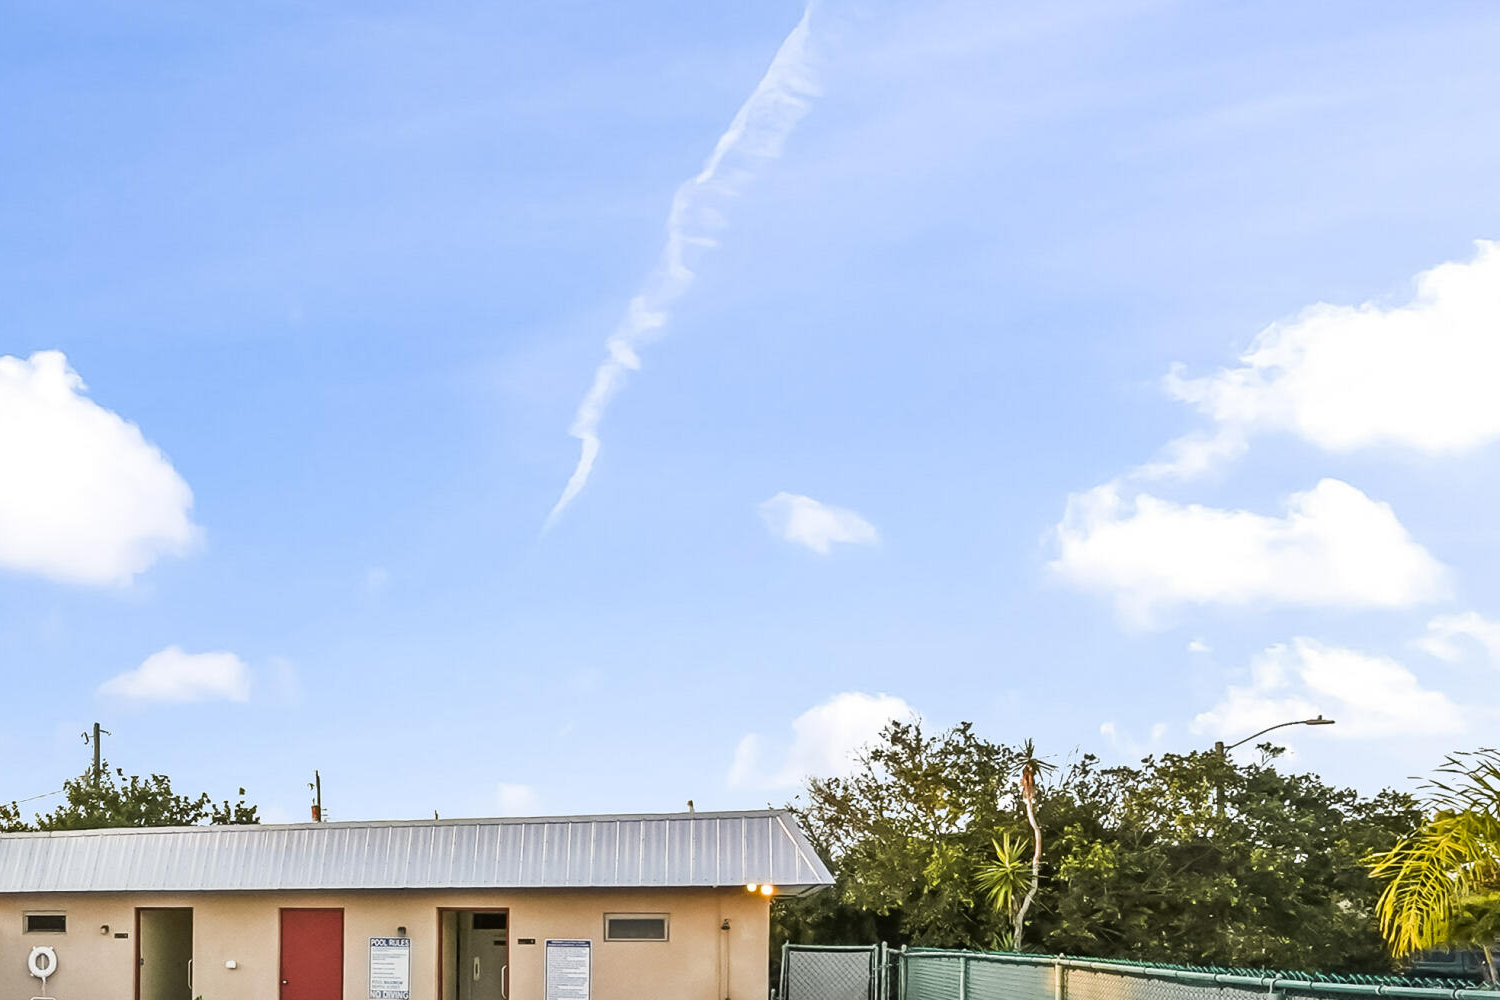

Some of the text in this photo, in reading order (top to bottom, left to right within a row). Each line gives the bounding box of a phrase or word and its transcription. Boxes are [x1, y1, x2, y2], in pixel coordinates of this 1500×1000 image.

[371, 938, 409, 947] POOL RULES
[371, 990, 409, 1000] NO DIVING
